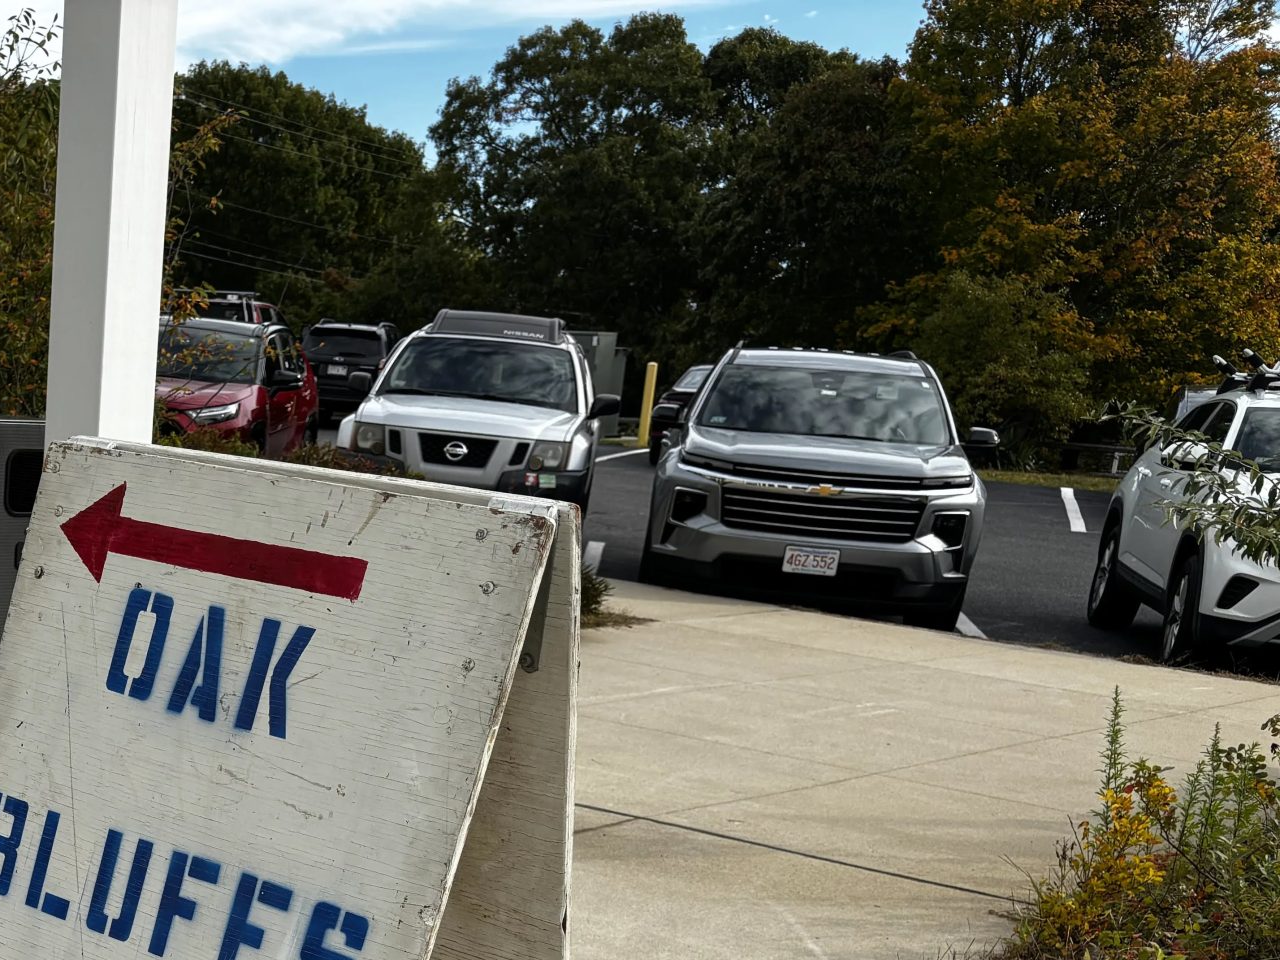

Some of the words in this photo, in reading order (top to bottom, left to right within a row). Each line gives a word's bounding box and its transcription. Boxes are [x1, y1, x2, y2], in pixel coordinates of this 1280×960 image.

[503, 329, 545, 339] NISSAN
[786, 553, 810, 568] 4GZ
[811, 555, 836, 570] 552
[106, 588, 316, 739] OAK
